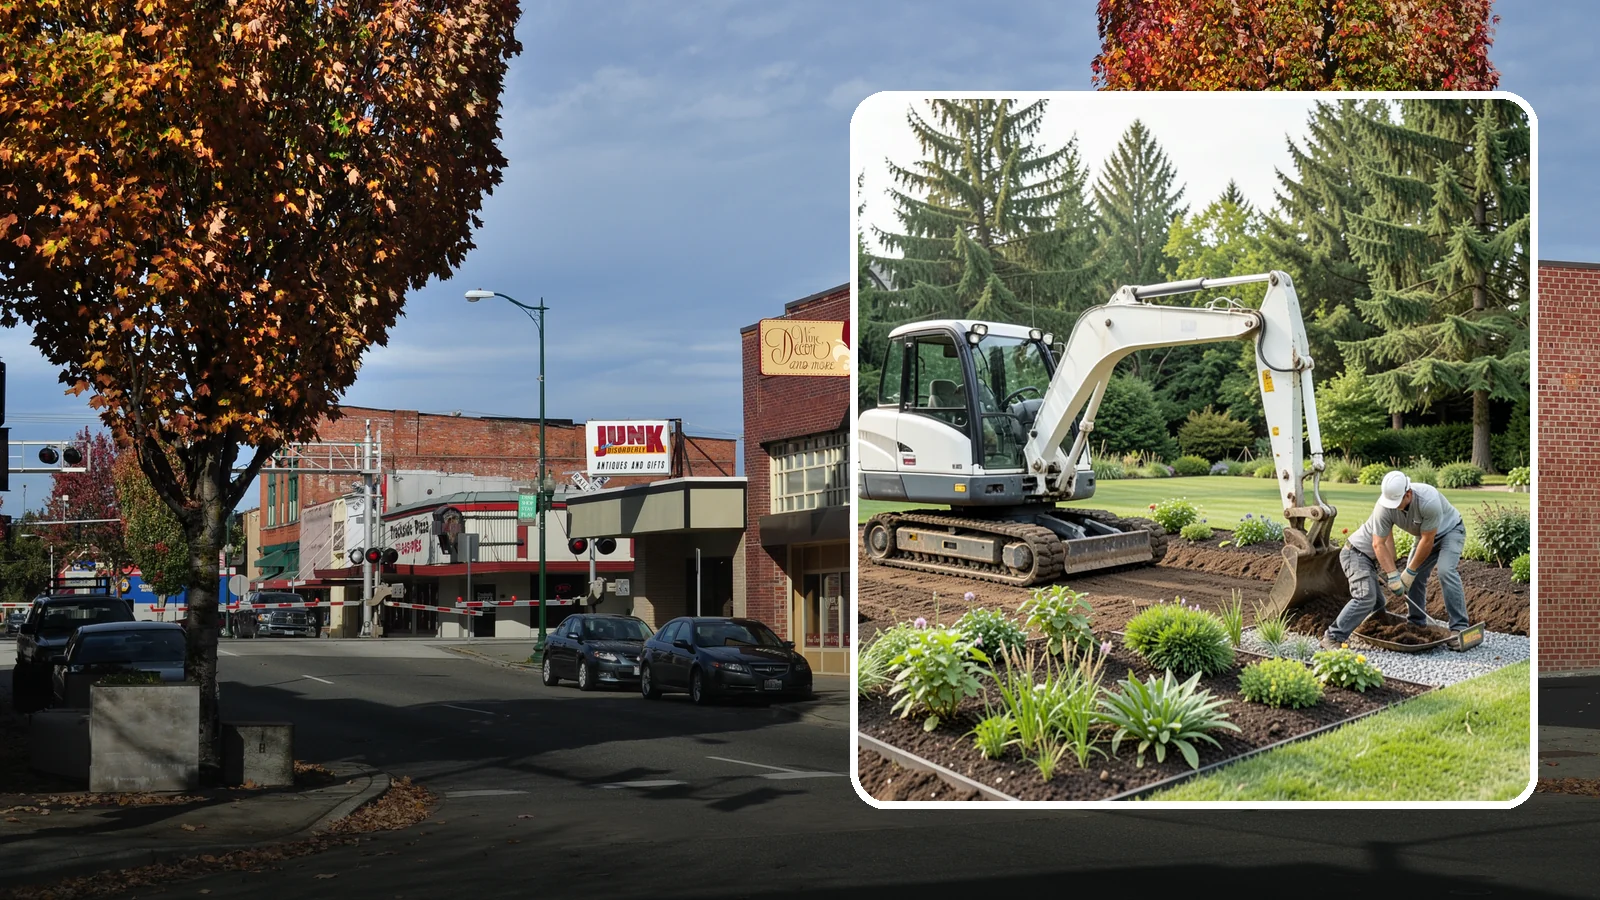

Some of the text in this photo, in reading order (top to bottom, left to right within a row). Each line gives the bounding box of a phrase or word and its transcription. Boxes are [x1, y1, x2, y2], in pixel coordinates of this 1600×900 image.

[595, 425, 665, 457] JUNK
[607, 446, 646, 454] DISORDERLY
[596, 460, 665, 470] ANTIQUES AND GIFTS
[590, 476, 608, 492] SING
[352, 498, 365, 511] CRO
[390, 519, 429, 540] Trackside Pizza
